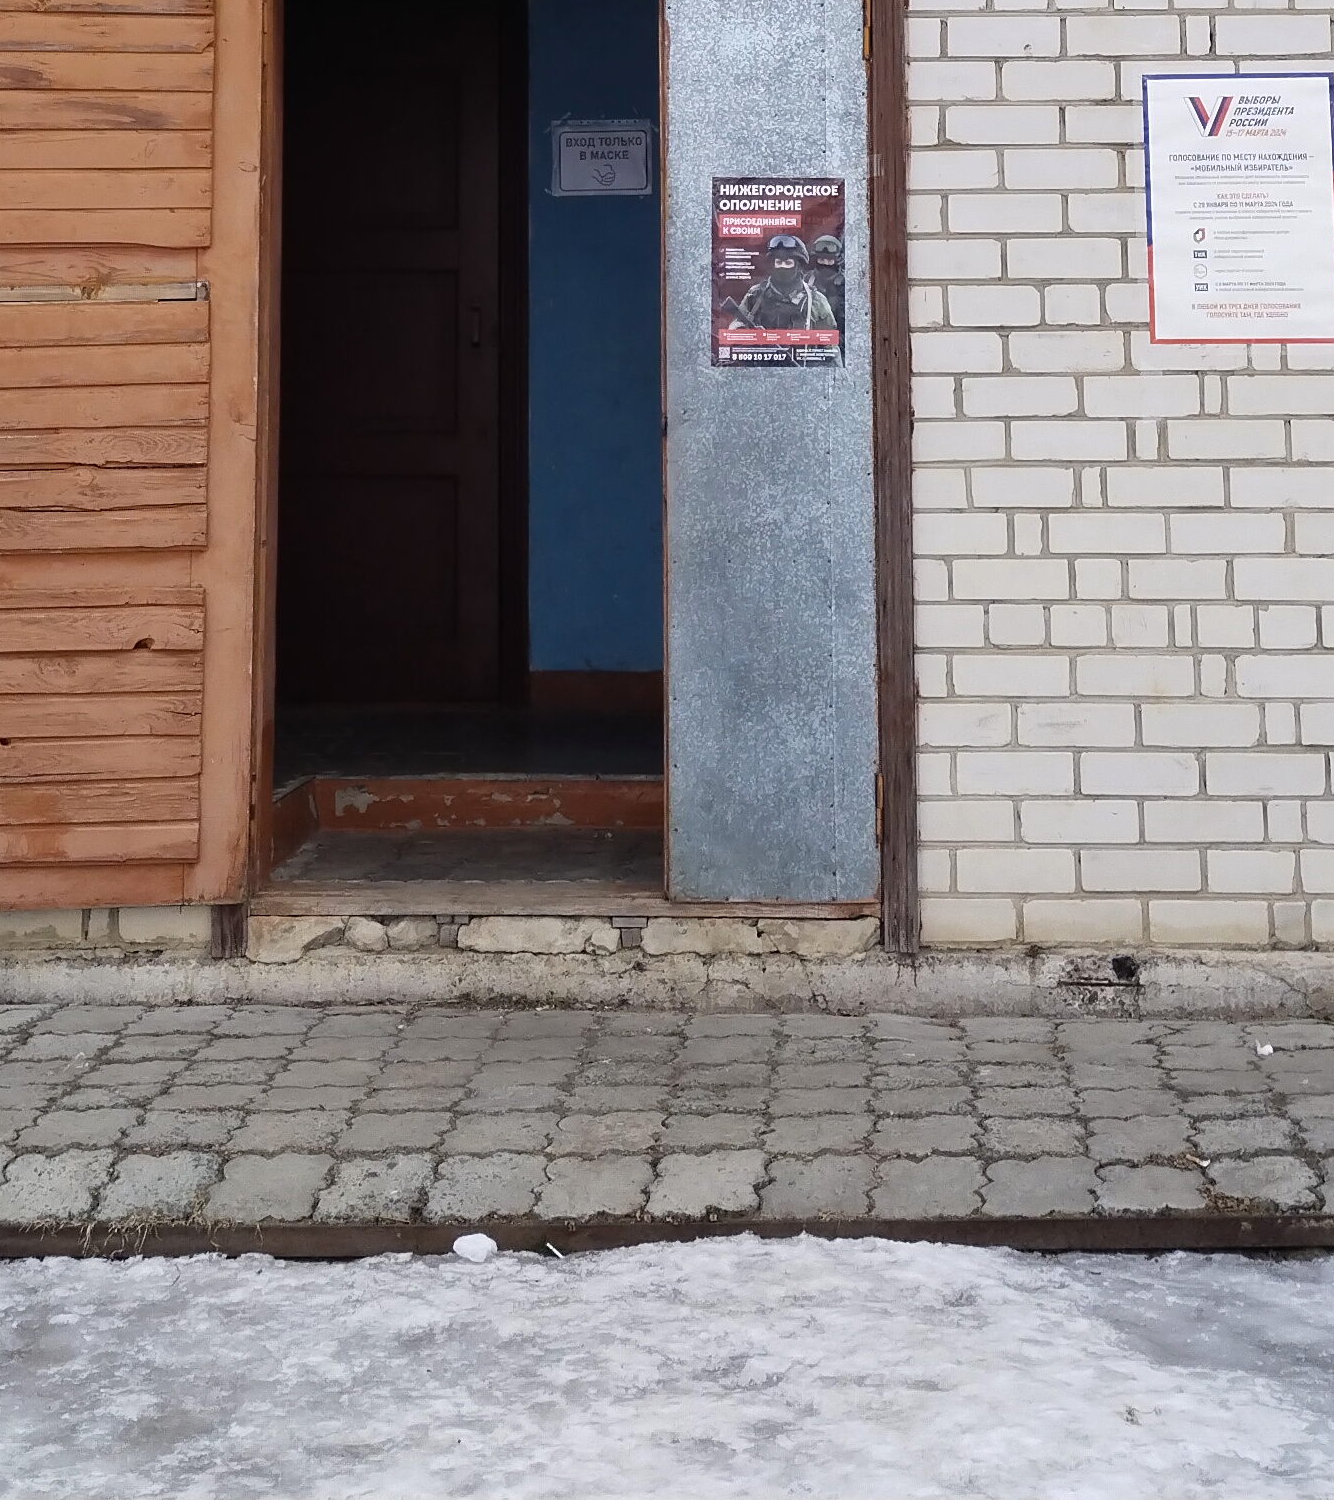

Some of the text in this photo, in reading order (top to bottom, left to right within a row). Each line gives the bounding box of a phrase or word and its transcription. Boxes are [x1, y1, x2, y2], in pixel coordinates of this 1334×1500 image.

[1237, 95, 1282, 105] ВЫБОРЫ
[1233, 106, 1295, 116] ПРЕЗИДЕНТА
[1229, 118, 1269, 128] РОССИИ
[1245, 129, 1268, 137] МАРТА
[565, 136, 643, 149] ВХОД ТОЛЬКО
[579, 150, 630, 161] В МАСКЕ
[1168, 153, 1308, 162] ГОЛОСОВАНИЕ ПО МЕСТУ НАХОЖДЕНИЯ
[719, 184, 839, 198] НИЖЕГОРОДСКОЕ
[719, 199, 802, 211] ОПОЛЧЕНИЕ
[722, 217, 797, 227] ПРИСОЕДИНЯЙСЯ
[722, 226, 761, 235] К СВОИМ
